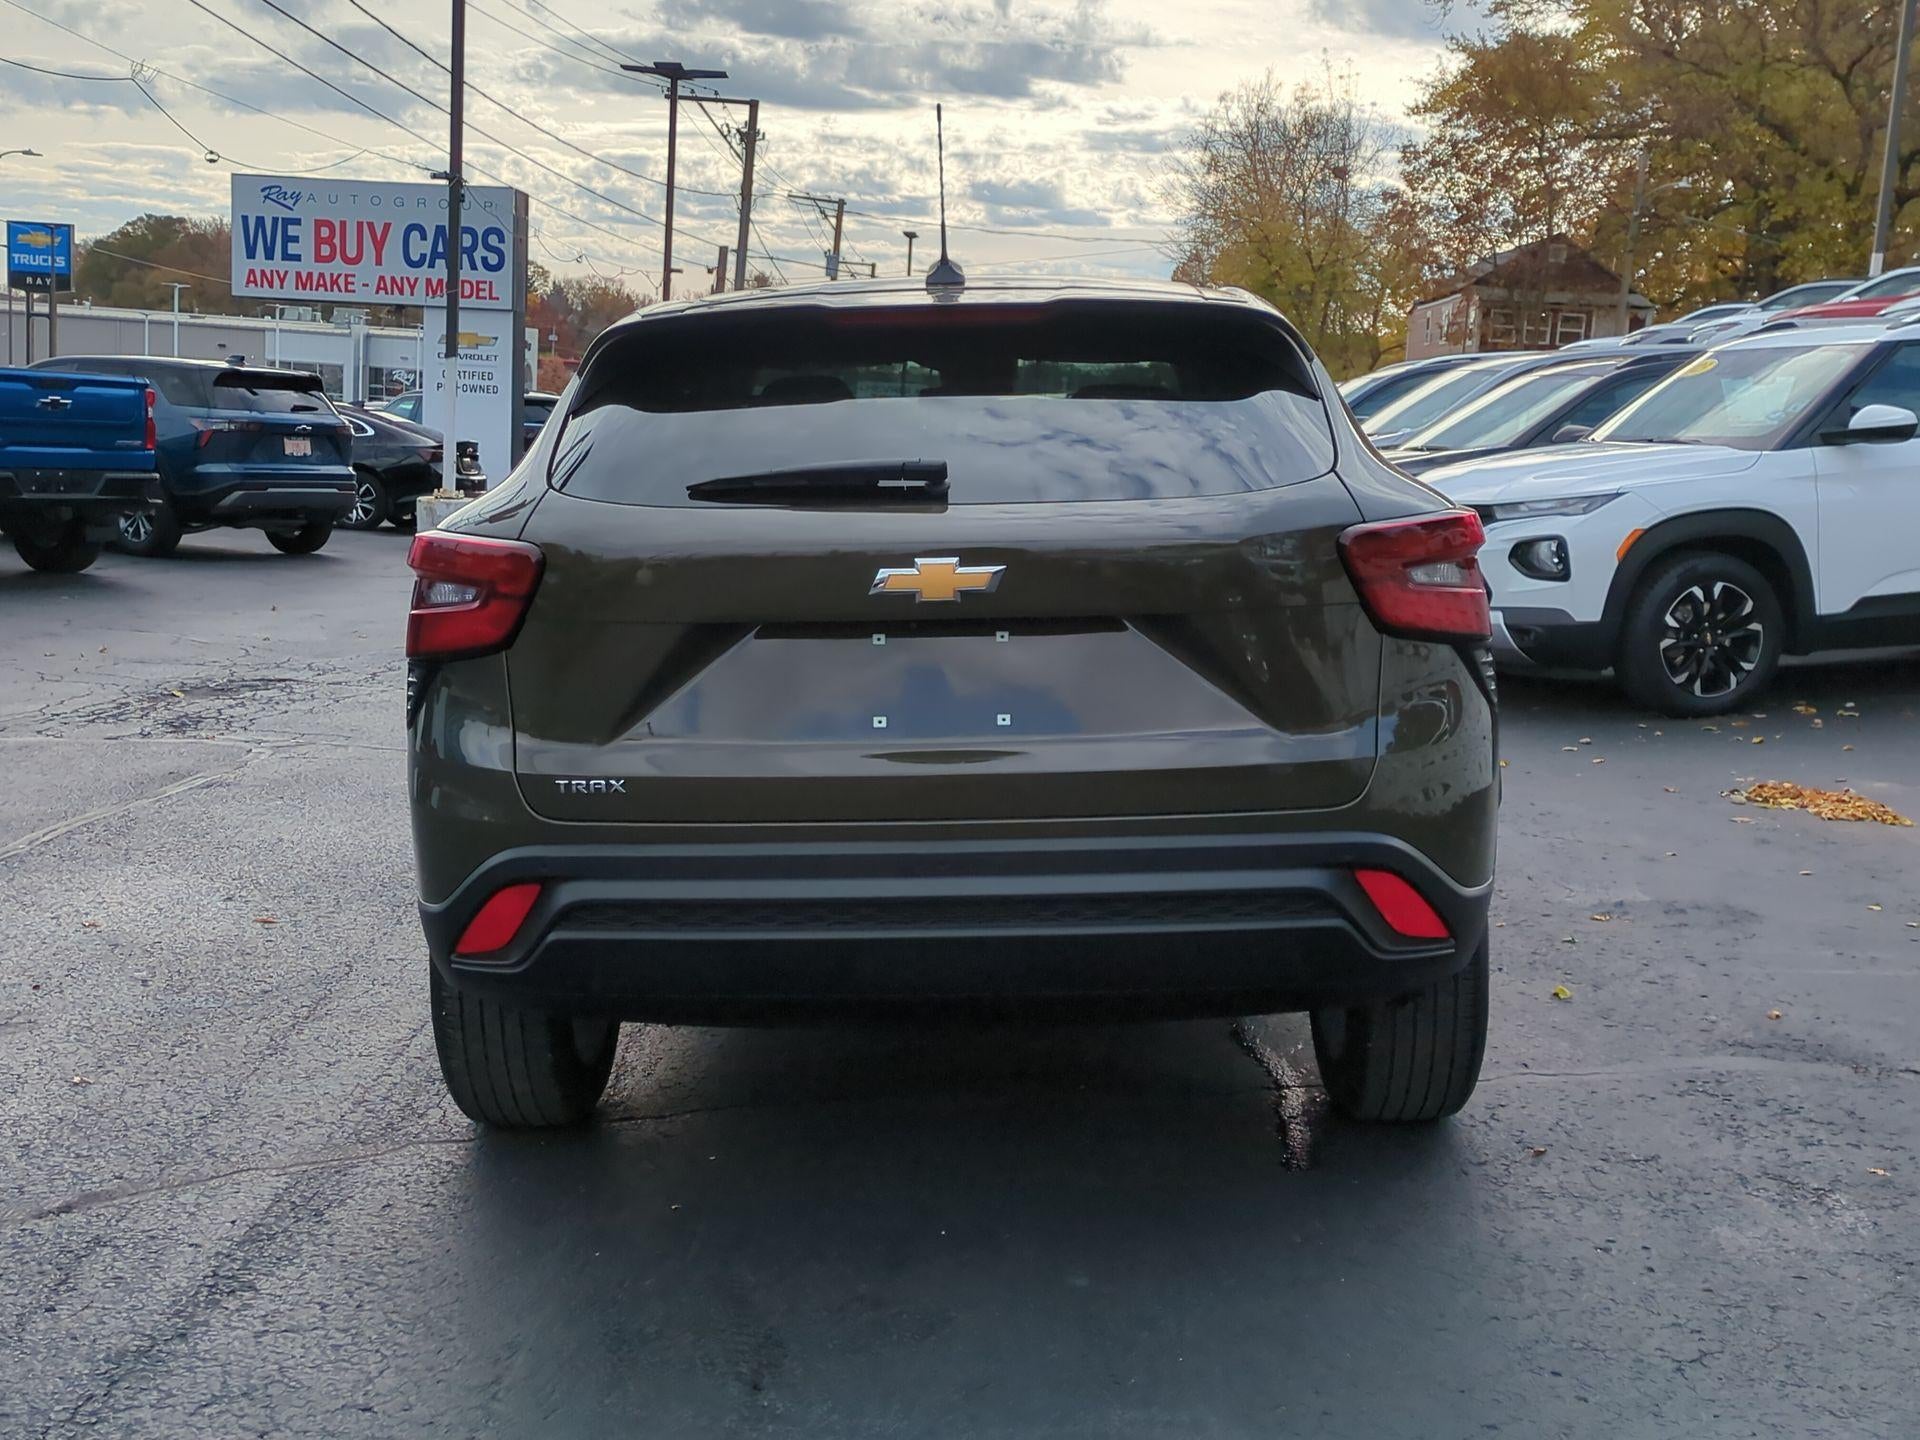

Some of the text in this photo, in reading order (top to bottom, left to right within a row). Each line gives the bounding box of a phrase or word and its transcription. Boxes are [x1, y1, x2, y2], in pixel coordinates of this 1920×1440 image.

[260, 185, 494, 212] Ray AUTOGROUP
[241, 214, 506, 272] WE BUY CARS
[26, 276, 51, 285] RAY
[245, 268, 289, 290] ANY
[295, 270, 356, 293] MAKE
[375, 275, 419, 297] ANY
[425, 278, 500, 300] MDEL
[437, 352, 499, 361] CVROLET
[442, 369, 494, 381] CRTIFIED
[436, 382, 499, 394] P-OWNED
[555, 779, 626, 794] TRAX
